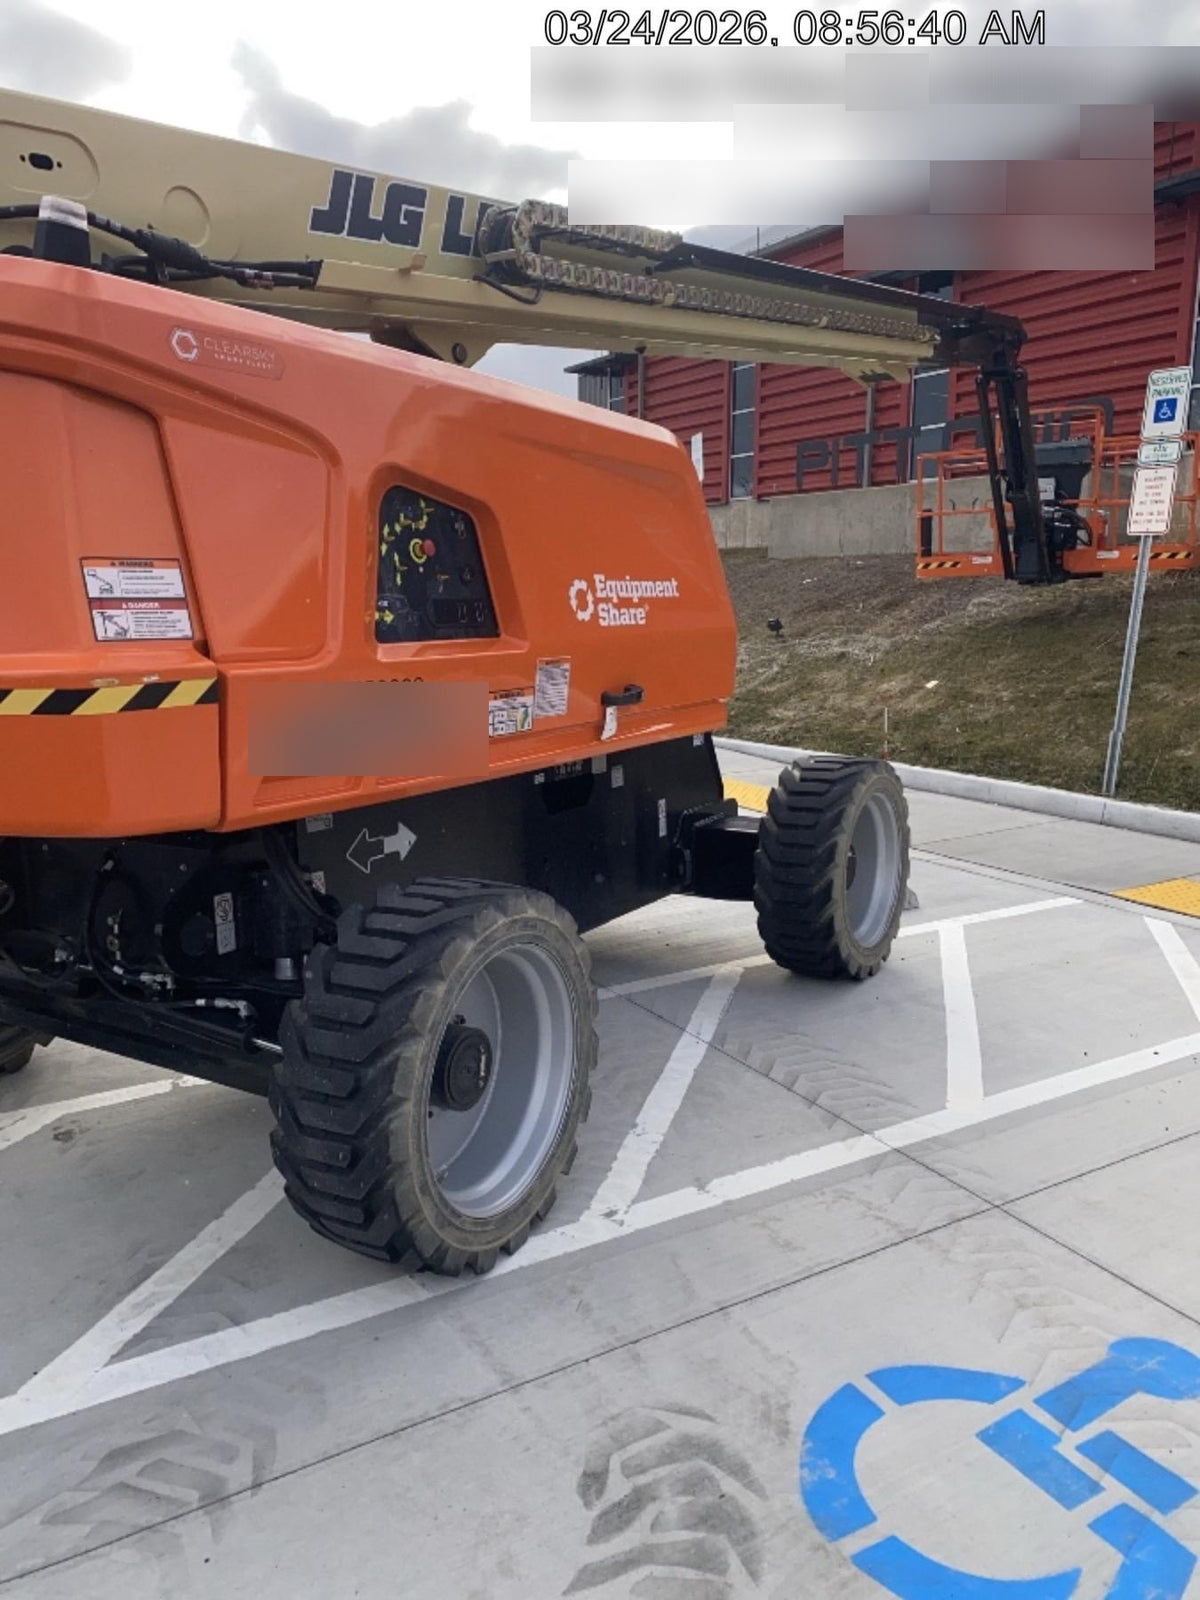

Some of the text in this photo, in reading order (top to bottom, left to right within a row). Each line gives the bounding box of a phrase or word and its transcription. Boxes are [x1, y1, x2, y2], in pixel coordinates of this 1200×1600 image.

[308, 168, 429, 249] JLG
[594, 574, 679, 602] Equipment
[598, 602, 647, 626] Share
